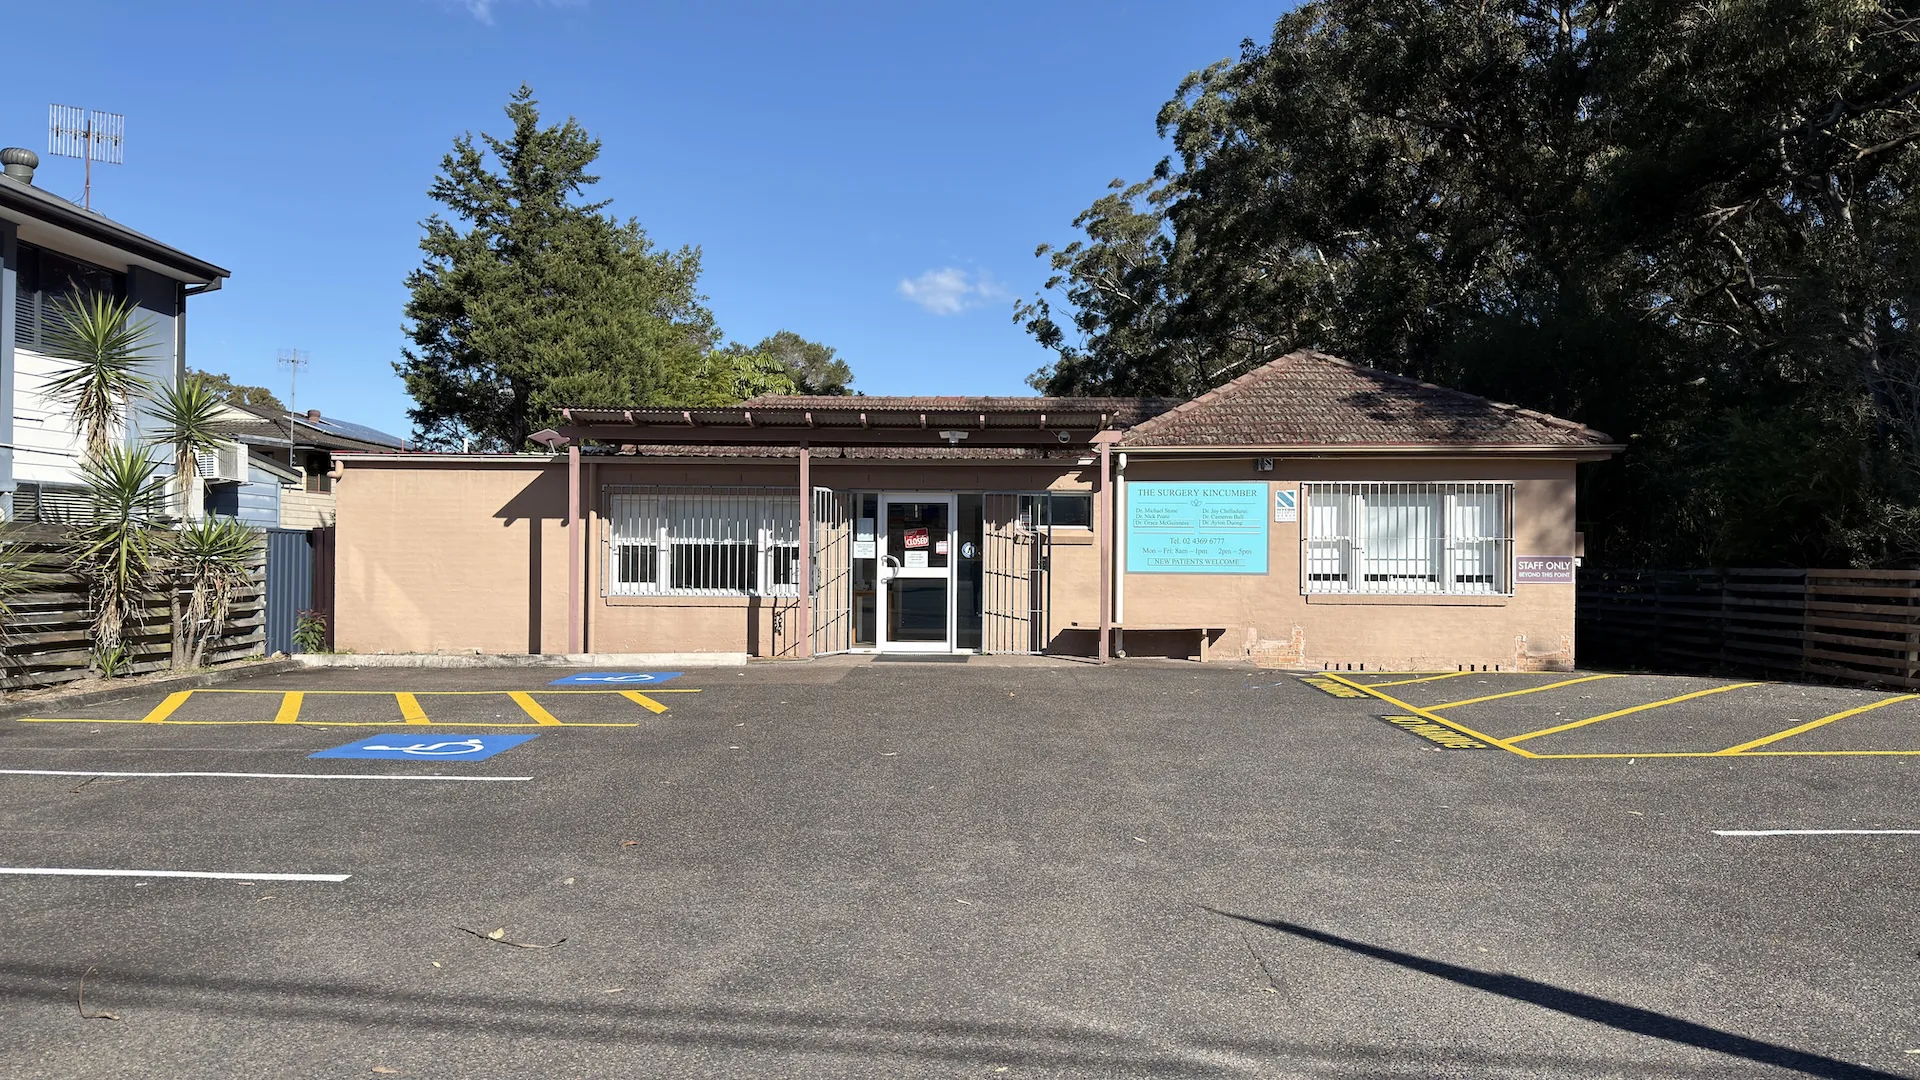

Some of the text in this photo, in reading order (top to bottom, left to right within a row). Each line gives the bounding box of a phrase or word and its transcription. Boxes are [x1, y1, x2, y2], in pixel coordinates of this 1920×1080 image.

[1138, 489, 1257, 497] THE SURGERY KINCUMBER
[906, 537, 928, 546] CLOSED
[1518, 561, 1571, 570] STAFF ONLY
